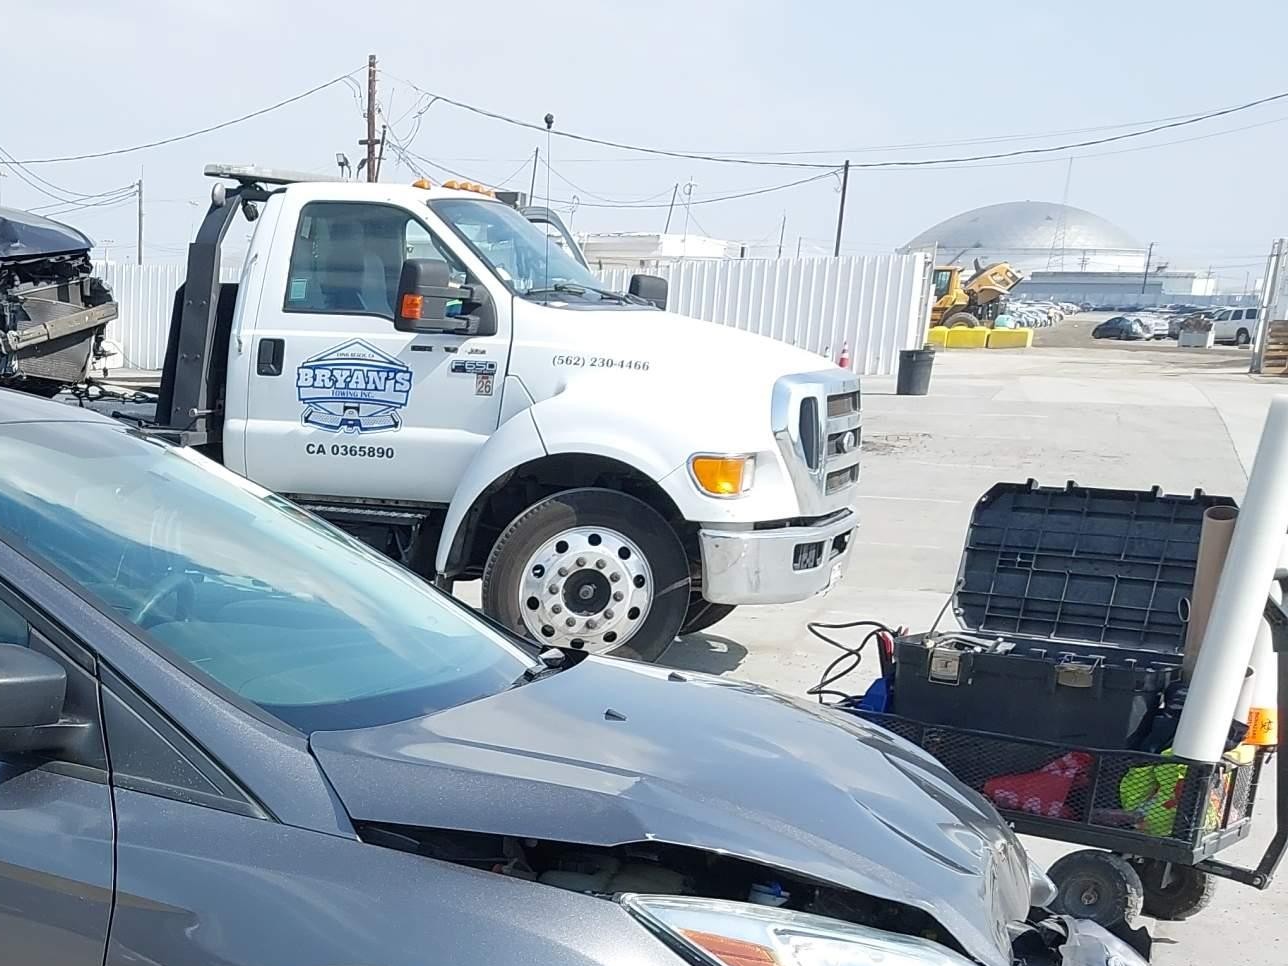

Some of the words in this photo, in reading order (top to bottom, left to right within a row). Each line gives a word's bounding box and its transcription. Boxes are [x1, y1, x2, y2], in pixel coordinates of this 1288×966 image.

[452, 361, 497, 371] F650
[552, 355, 586, 368] (562)
[590, 357, 650, 371] 230-4466
[297, 367, 412, 393] BRYAN'S
[477, 380, 491, 394] 26
[331, 389, 358, 398] TOWING
[360, 390, 375, 399] INC.
[306, 443, 326, 455] CA
[331, 444, 394, 459] 0365890
